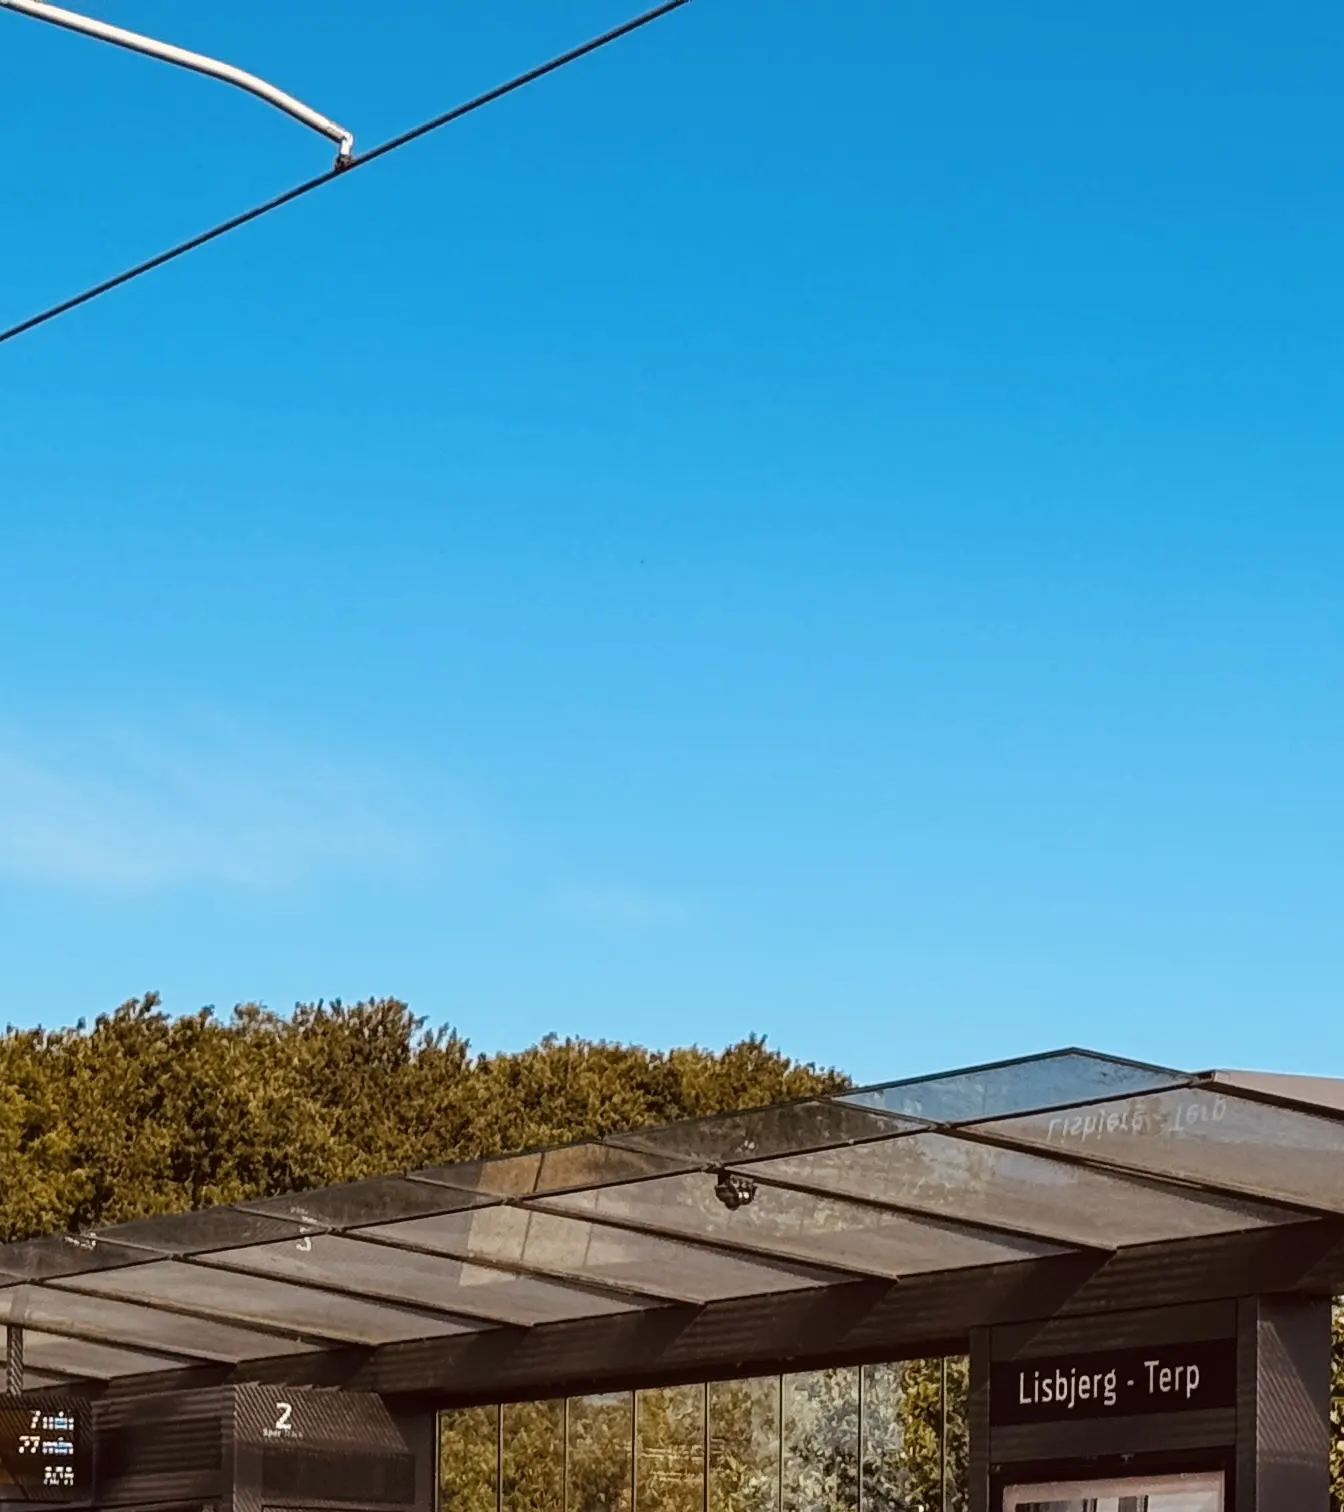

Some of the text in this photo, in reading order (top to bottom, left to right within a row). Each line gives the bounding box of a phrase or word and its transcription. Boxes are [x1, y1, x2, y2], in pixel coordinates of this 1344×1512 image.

[1019, 1368, 1117, 1409] Lisbjerg
[1144, 1360, 1200, 1399] Terp
[276, 1402, 292, 1429] 2
